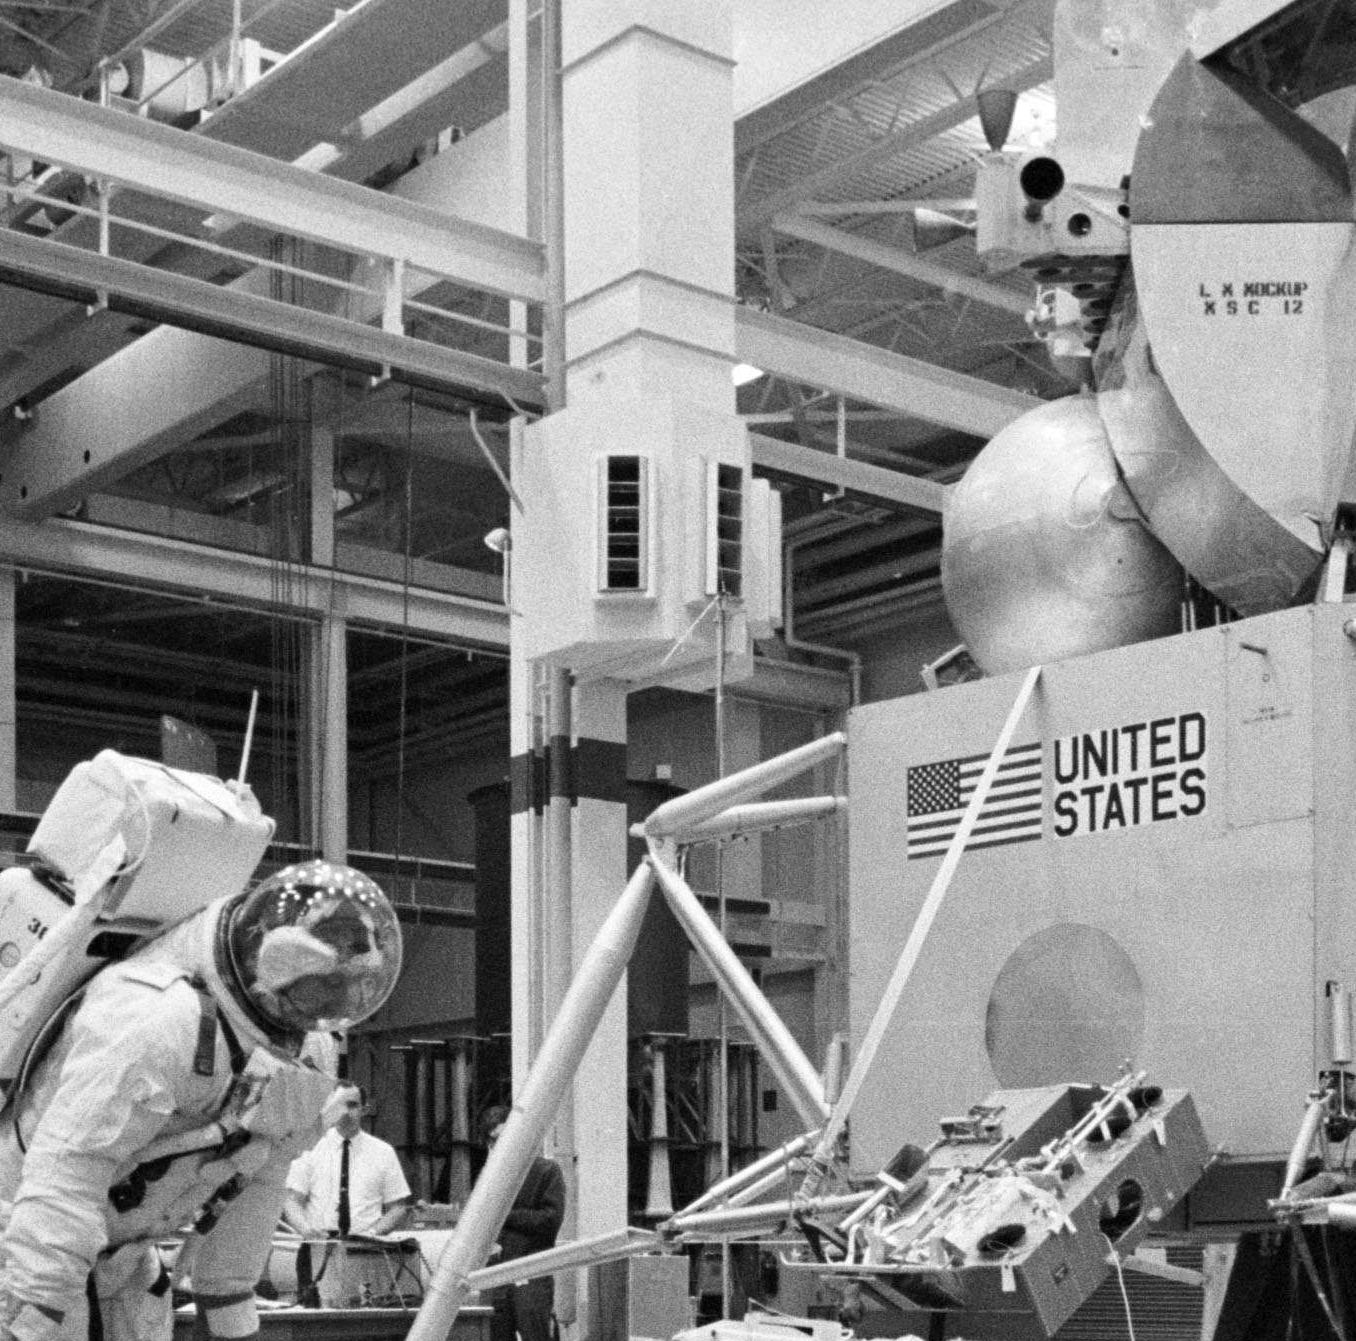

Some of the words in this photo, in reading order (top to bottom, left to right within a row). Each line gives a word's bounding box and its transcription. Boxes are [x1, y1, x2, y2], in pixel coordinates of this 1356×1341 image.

[1199, 283, 1211, 298] L
[1243, 282, 1308, 297] MOCKUP
[1227, 301, 1238, 315] S
[1248, 301, 1260, 315] C
[1284, 300, 1303, 315] 12
[1054, 712, 1206, 785] UNITED
[1054, 767, 1206, 837] STATES
